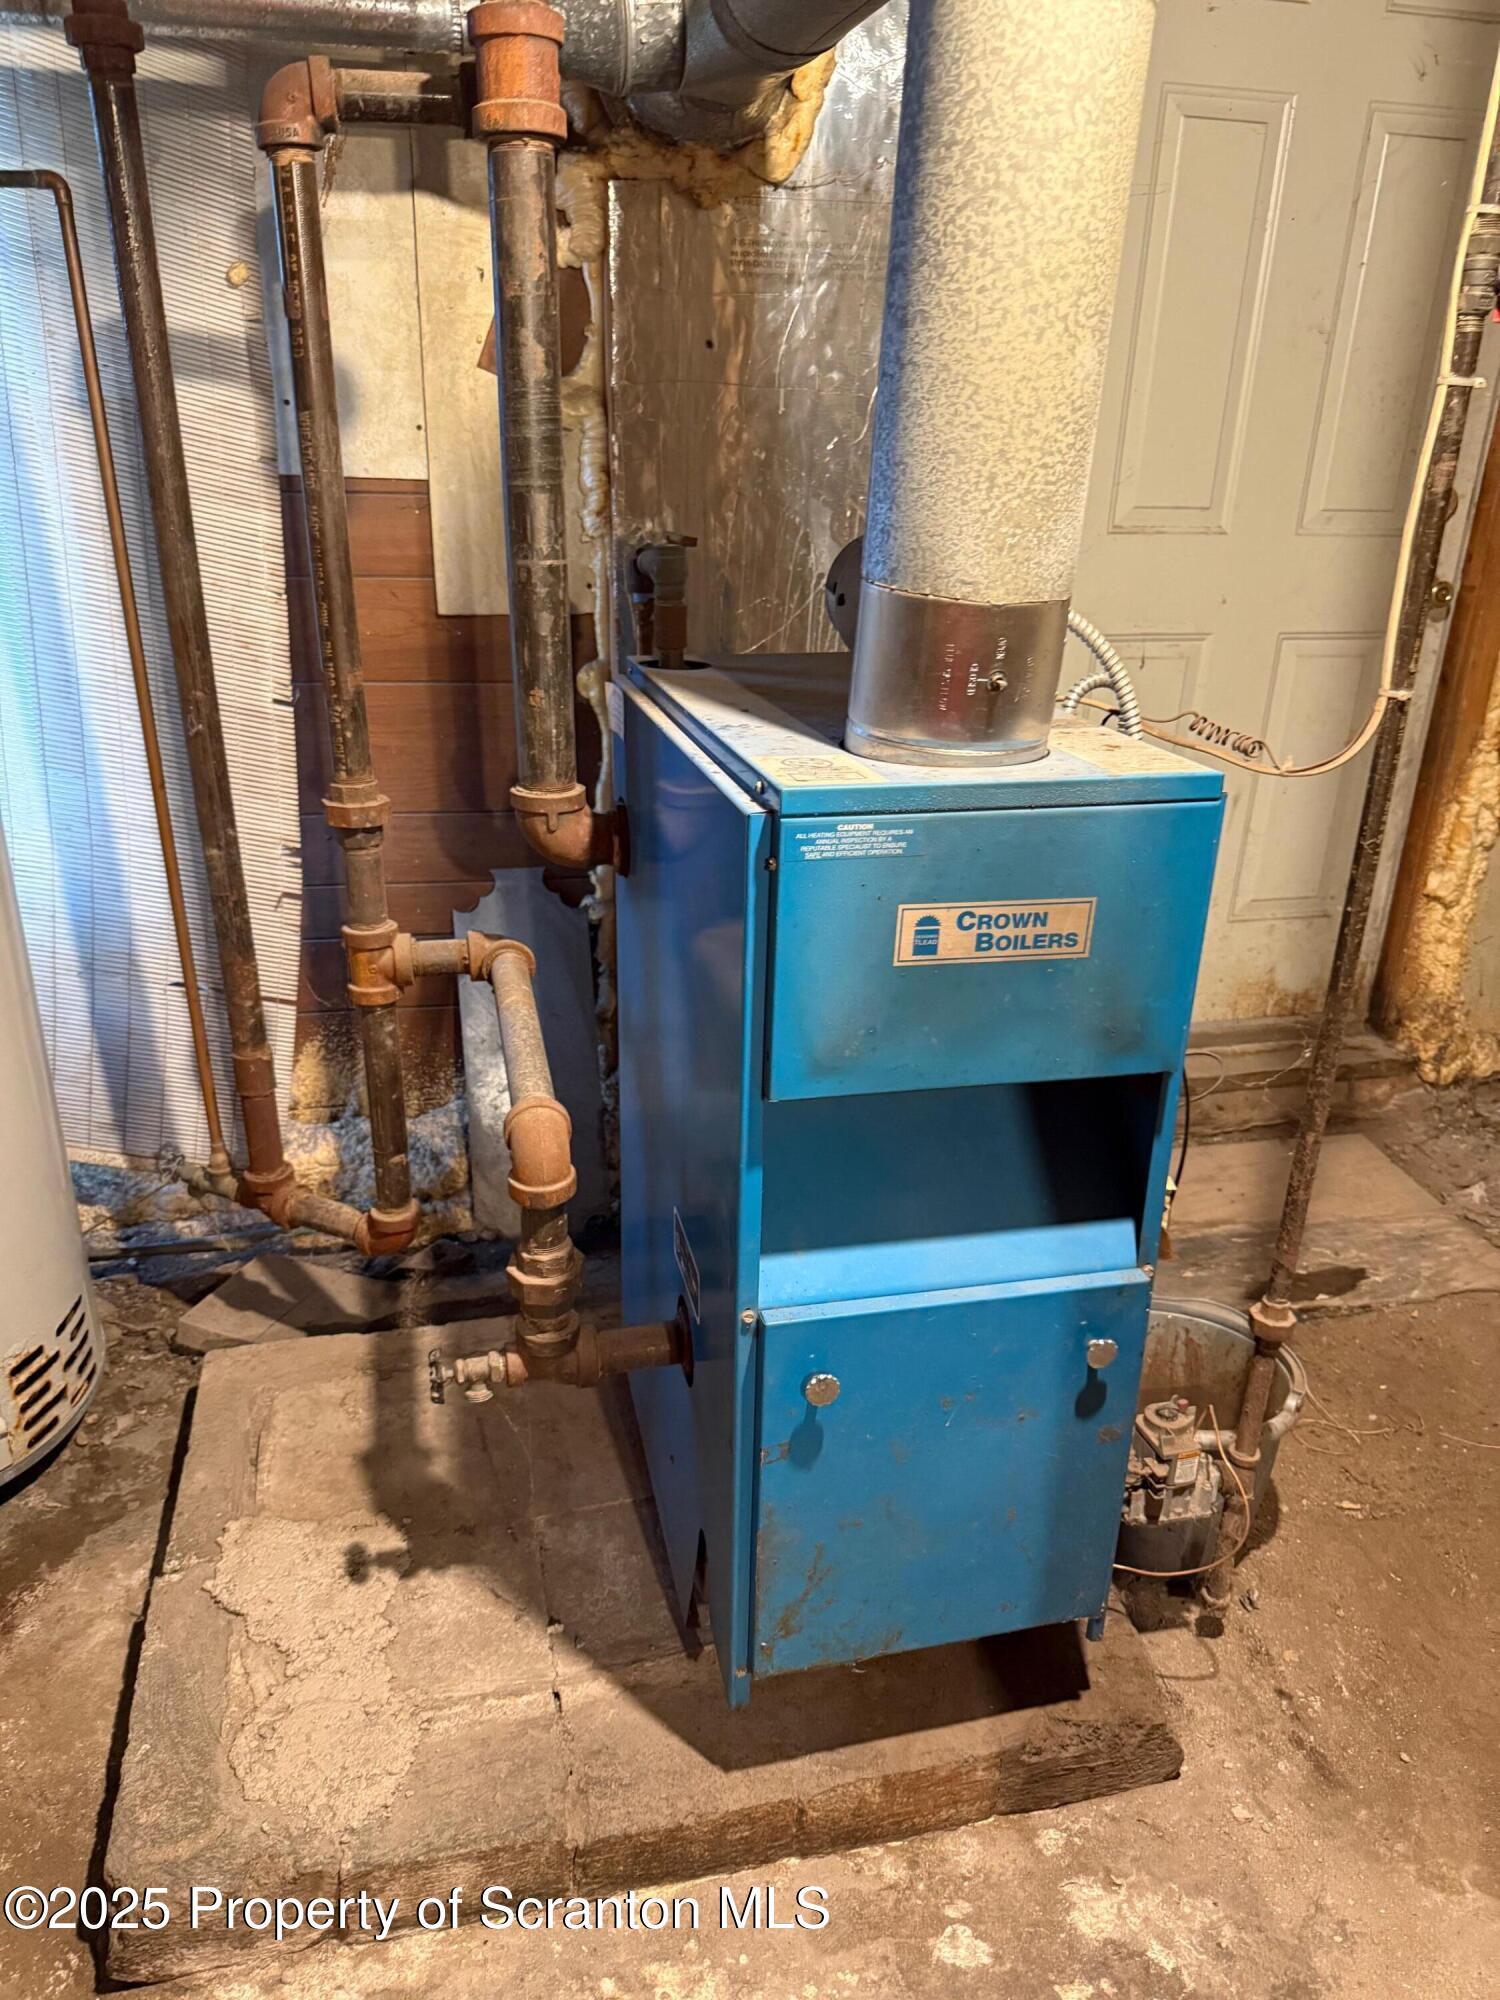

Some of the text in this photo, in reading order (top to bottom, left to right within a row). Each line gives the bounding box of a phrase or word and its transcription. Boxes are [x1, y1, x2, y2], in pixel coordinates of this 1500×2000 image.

[837, 823, 874, 831] CAUTION
[956, 911, 1049, 931] CROWN
[975, 932, 1079, 952] BOILERS
